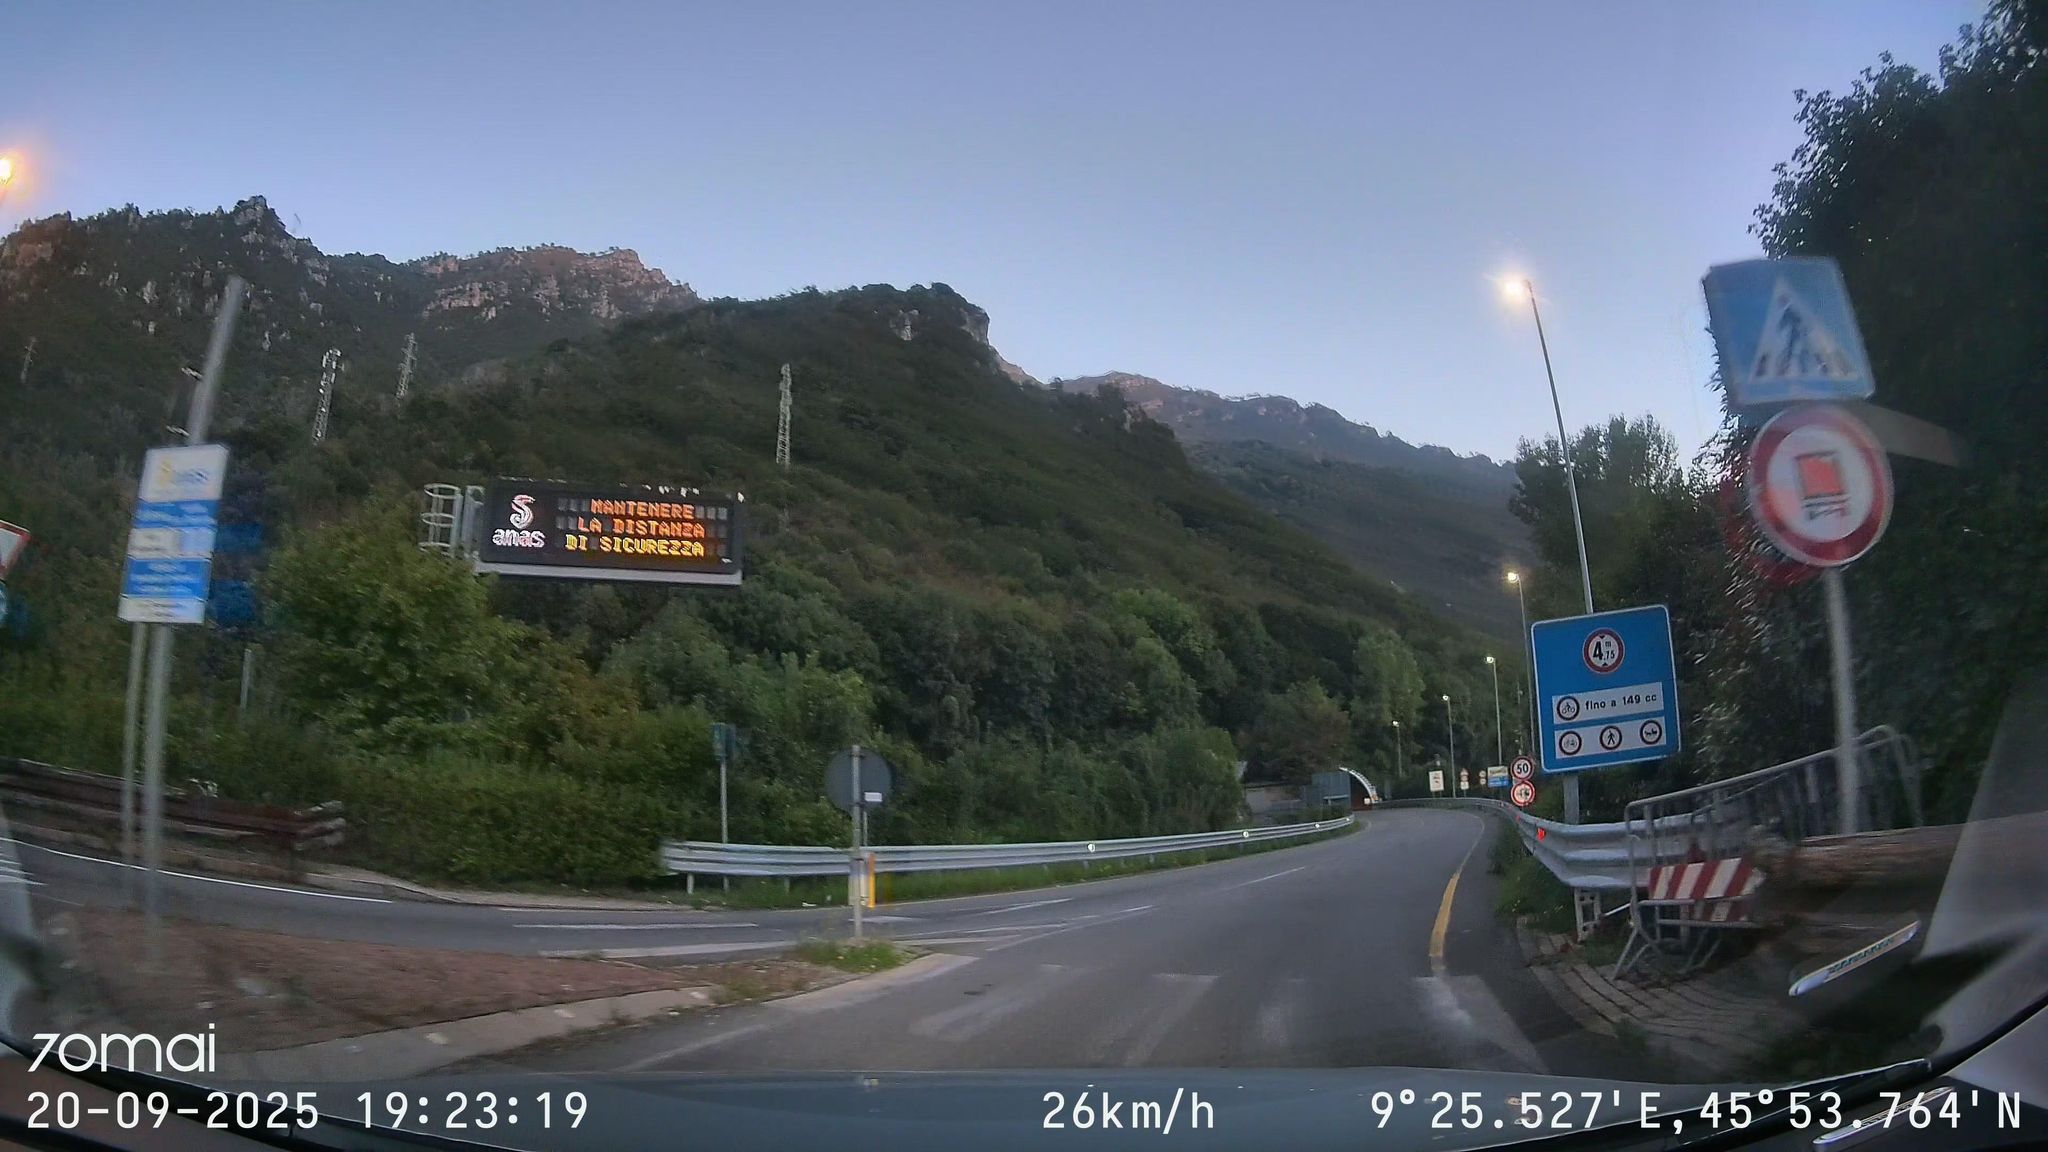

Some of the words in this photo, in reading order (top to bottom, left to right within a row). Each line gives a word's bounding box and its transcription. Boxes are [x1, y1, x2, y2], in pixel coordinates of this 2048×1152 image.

[591, 498, 695, 520] MANTENERE
[578, 516, 602, 533] LA
[612, 518, 705, 539] DISTANZA
[492, 529, 546, 548] anas
[565, 534, 588, 551] DI
[600, 536, 705, 557] SICUREZZA
[1585, 700, 1606, 711] fino
[1622, 694, 1641, 706] 149
[1645, 694, 1657, 703] cc
[1517, 762, 1529, 775] 50
